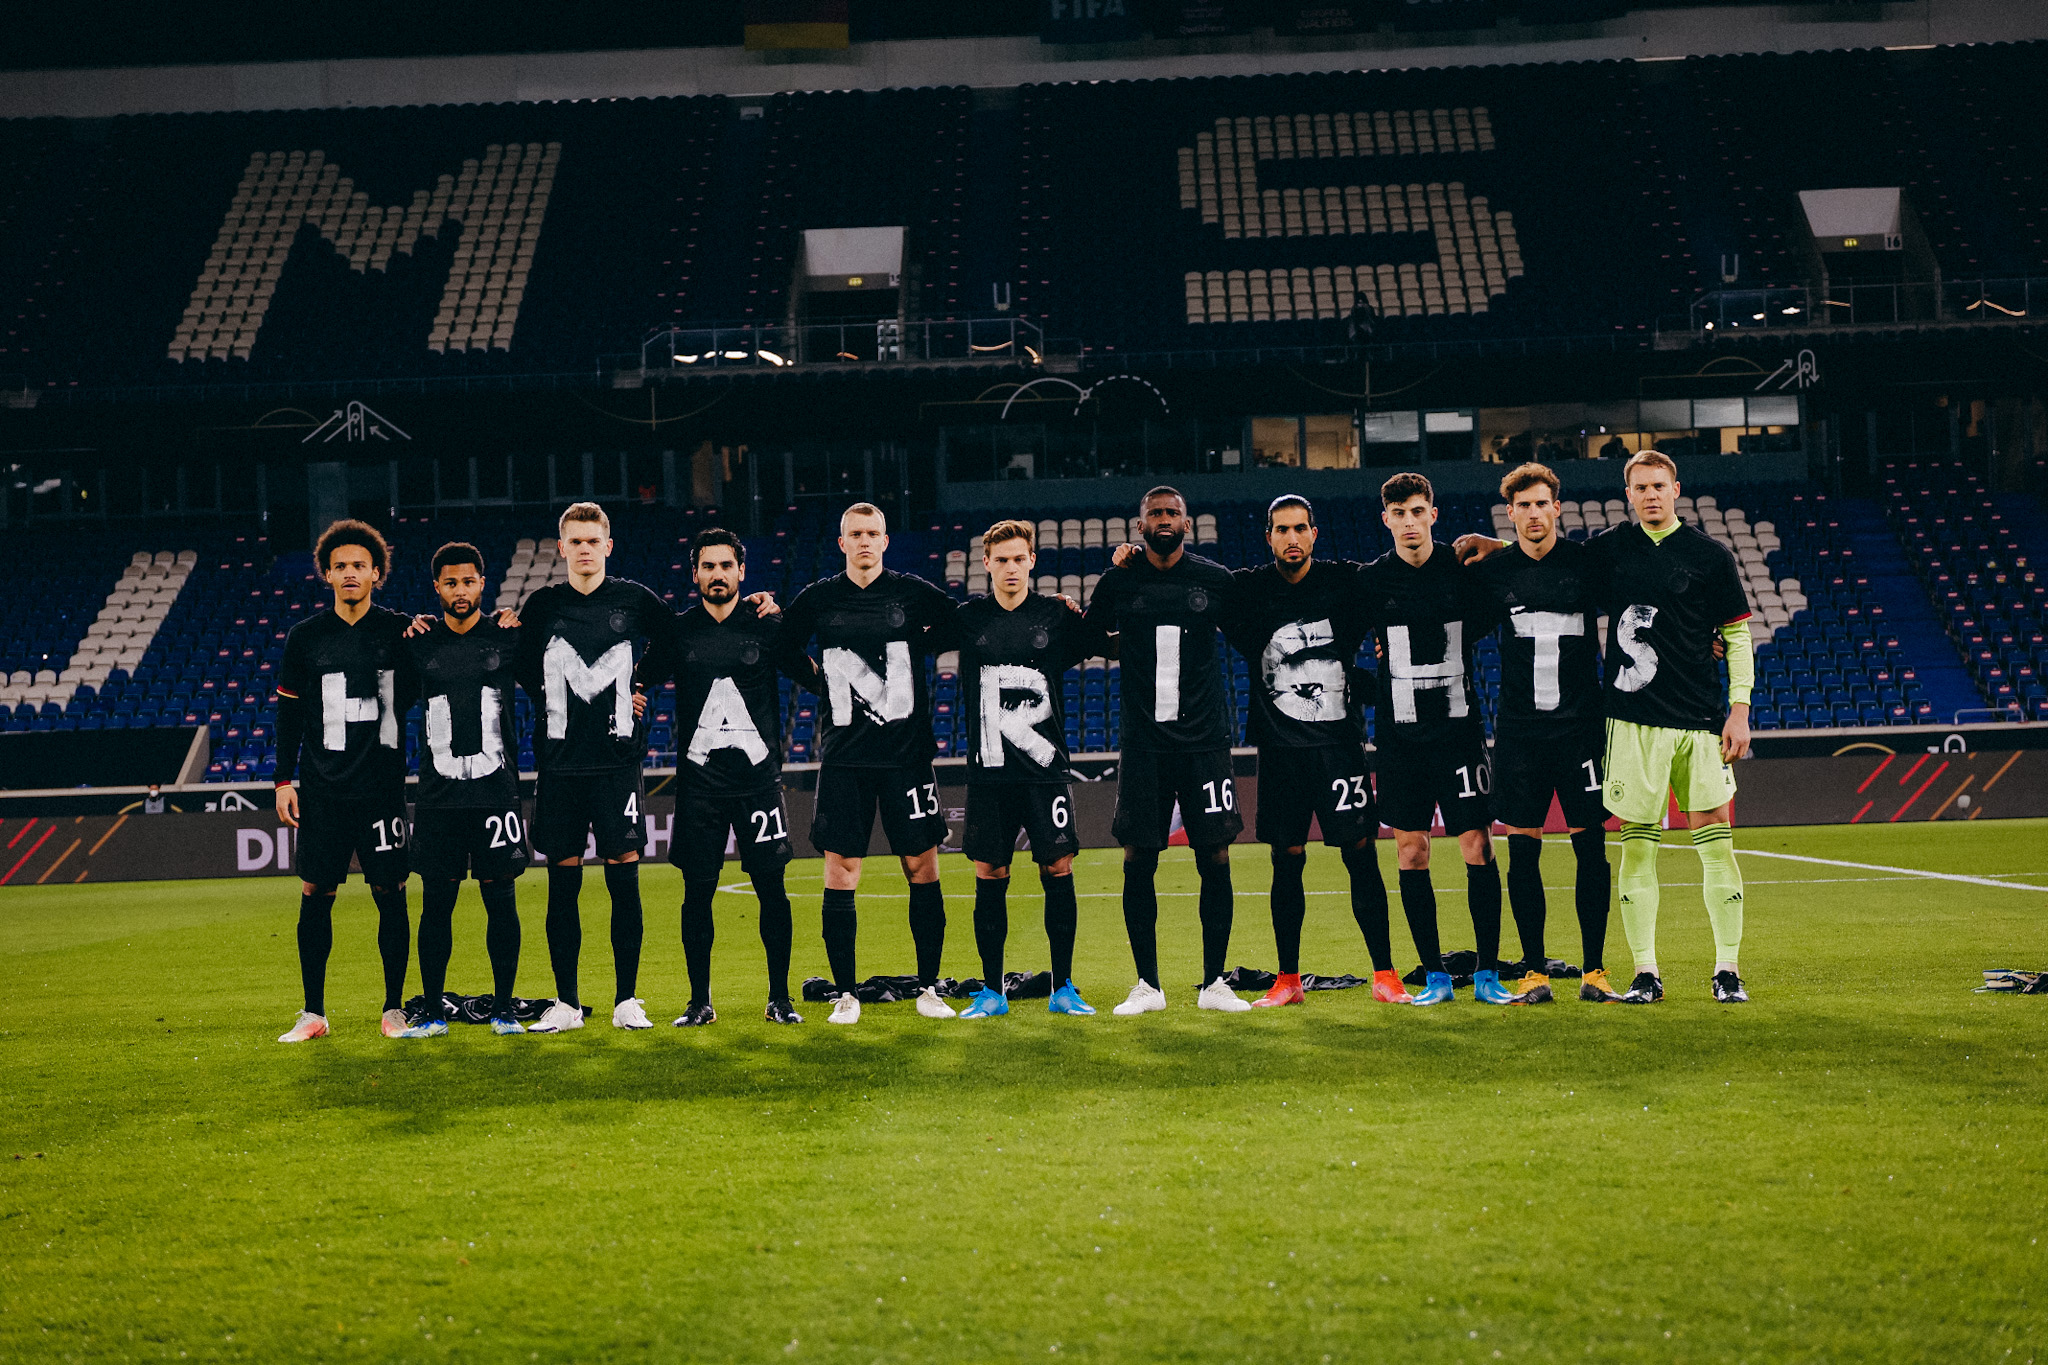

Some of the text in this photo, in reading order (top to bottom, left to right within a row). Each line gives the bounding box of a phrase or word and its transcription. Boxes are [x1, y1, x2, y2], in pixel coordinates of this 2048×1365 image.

[1202, 778, 1233, 813] 16
[1332, 775, 1368, 811] 23
[1455, 763, 1490, 798] 10
[624, 792, 639, 824] 4
[906, 783, 939, 819] 13
[1052, 796, 1068, 828] 6
[372, 817, 406, 852] 19
[485, 811, 521, 848] 20
[751, 807, 787, 843] 21
[237, 827, 298, 871] DI
